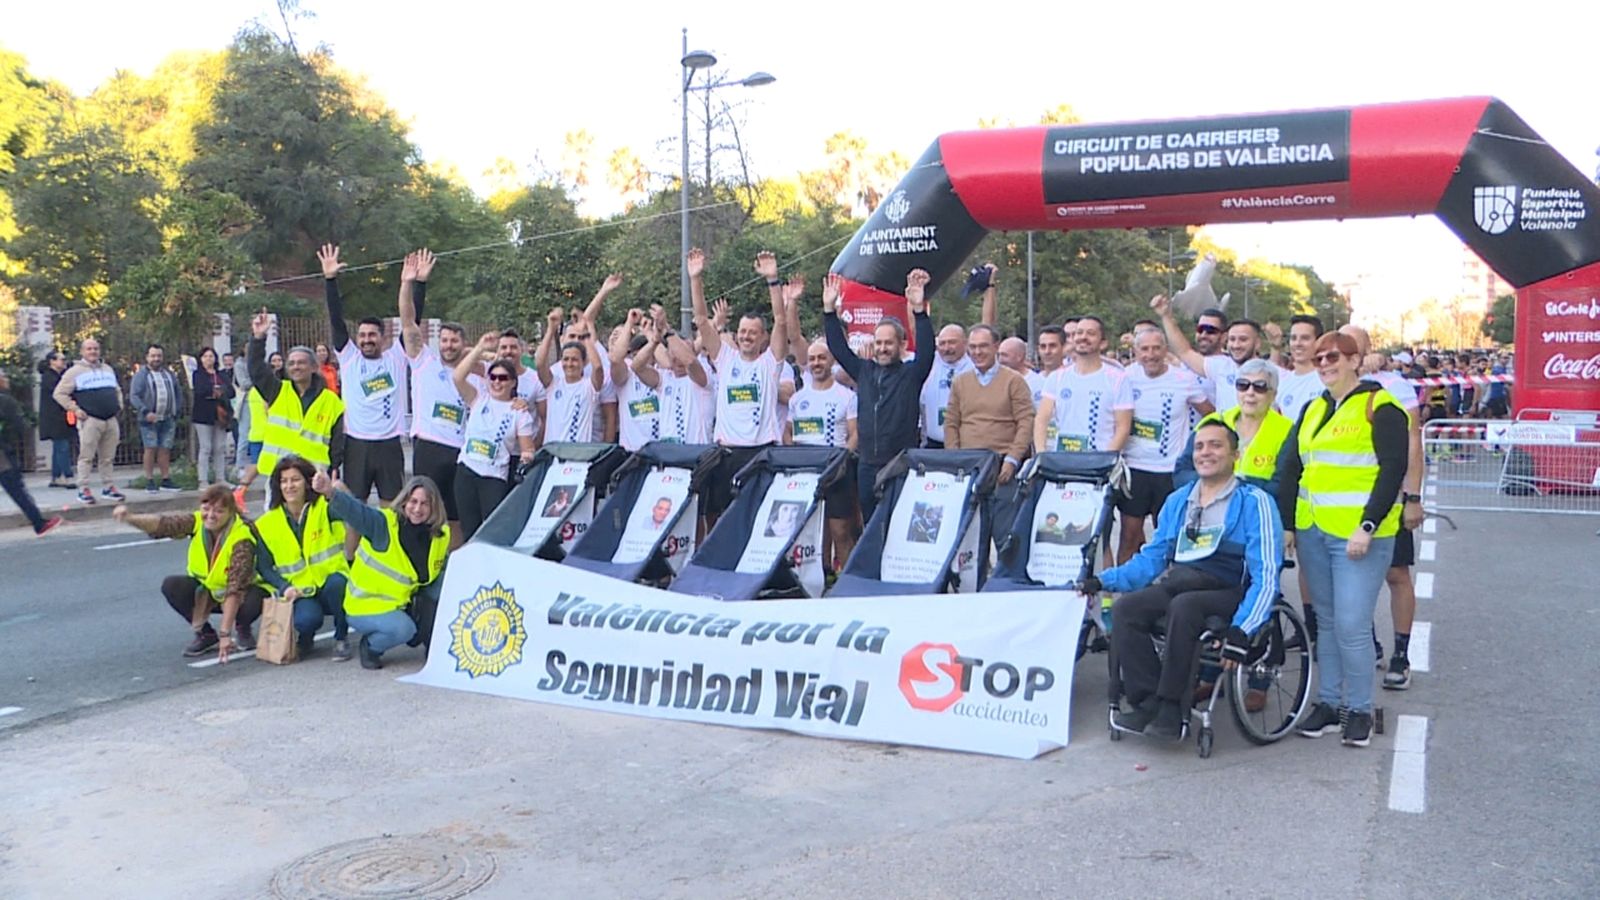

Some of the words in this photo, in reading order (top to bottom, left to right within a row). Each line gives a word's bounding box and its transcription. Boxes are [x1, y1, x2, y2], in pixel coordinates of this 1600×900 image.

[1054, 136, 1133, 155] CIRCUIT
[1136, 134, 1162, 150] DE
[1166, 127, 1281, 149] CARRERES
[1080, 150, 1190, 175] POPULARS
[1194, 149, 1222, 169] DE
[1225, 143, 1335, 167] VALÈNCIA
[1221, 194, 1336, 208] #ValènciaCorre
[1522, 187, 1581, 199] Fundació
[1521, 199, 1584, 210] Esportiva
[1521, 209, 1586, 221] Municipal
[1520, 220, 1577, 231] València
[861, 226, 937, 244] AJUNTAMENT
[859, 244, 873, 256] DE
[877, 239, 939, 254] VALÈNCIA
[548, 592, 741, 639] València
[741, 620, 835, 646] por
[836, 620, 890, 655] la
[909, 647, 1056, 703] STOP
[537, 650, 763, 716] Seguridad
[773, 669, 870, 727] Vial
[953, 701, 1049, 729] accidentes
